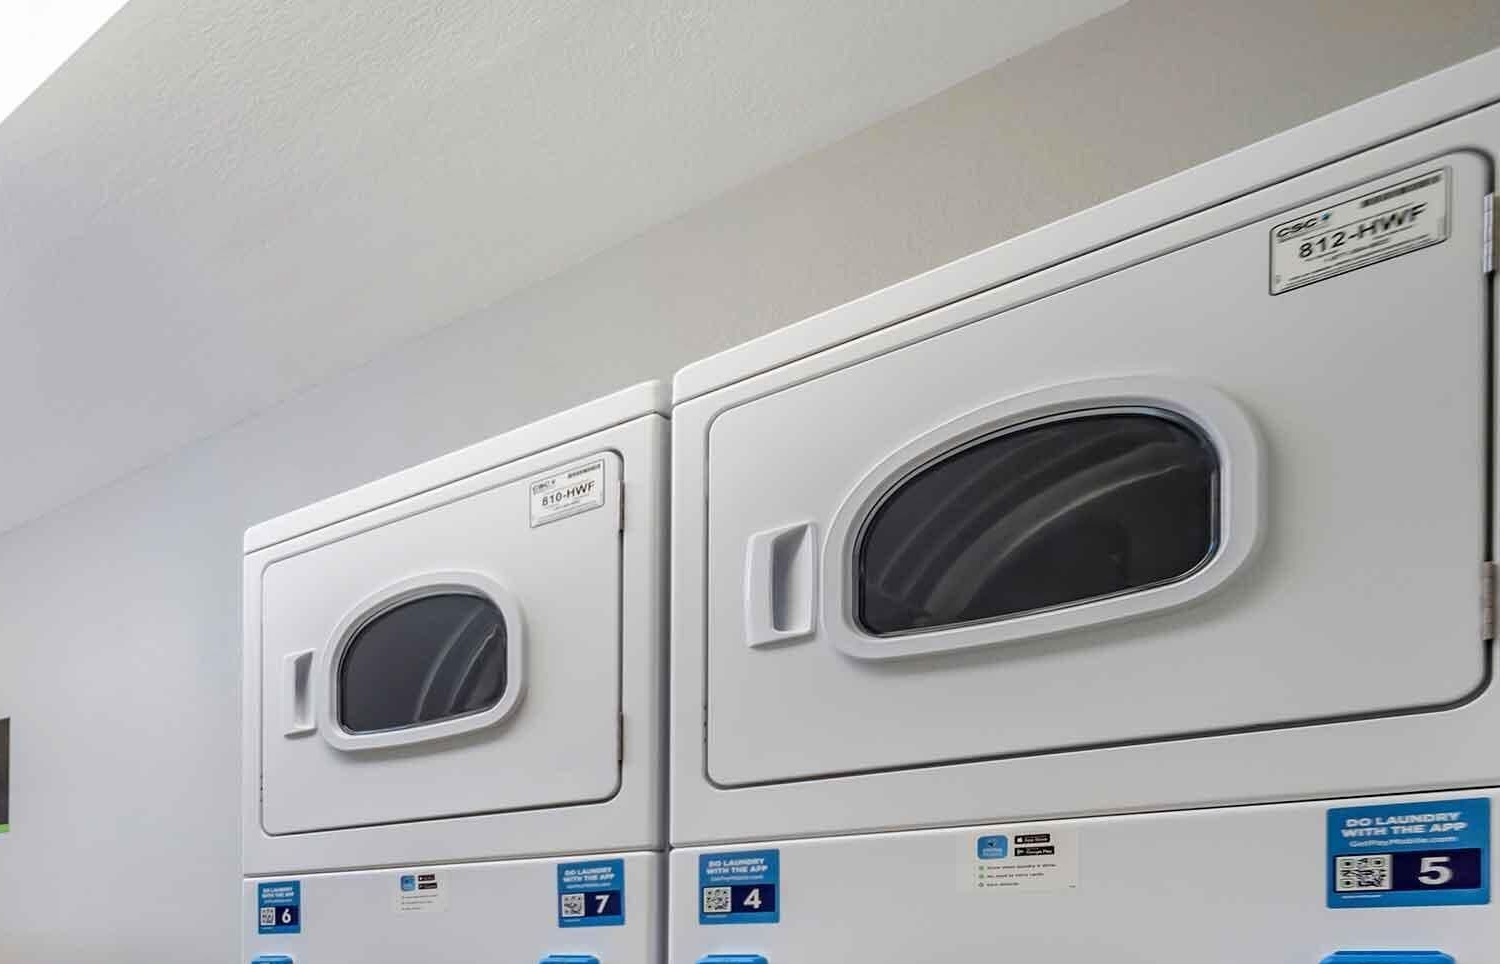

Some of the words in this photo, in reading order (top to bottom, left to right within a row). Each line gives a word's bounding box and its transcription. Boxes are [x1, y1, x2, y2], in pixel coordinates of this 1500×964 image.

[1276, 218, 1317, 237] CSC
[1299, 202, 1428, 258] 812-HWF
[542, 480, 595, 506] 810-HWF
[1346, 818, 1372, 827] DO
[1375, 812, 1462, 825] LAUNDRY
[1341, 828, 1387, 838] WITH
[1391, 825, 1425, 834] THE
[1429, 822, 1468, 832] APP
[731, 866, 749, 874] THE
[750, 864, 768, 873] APP
[1418, 857, 1452, 885] 5
[595, 895, 611, 914] 7
[743, 888, 762, 909] 4
[282, 908, 291, 923] 6
